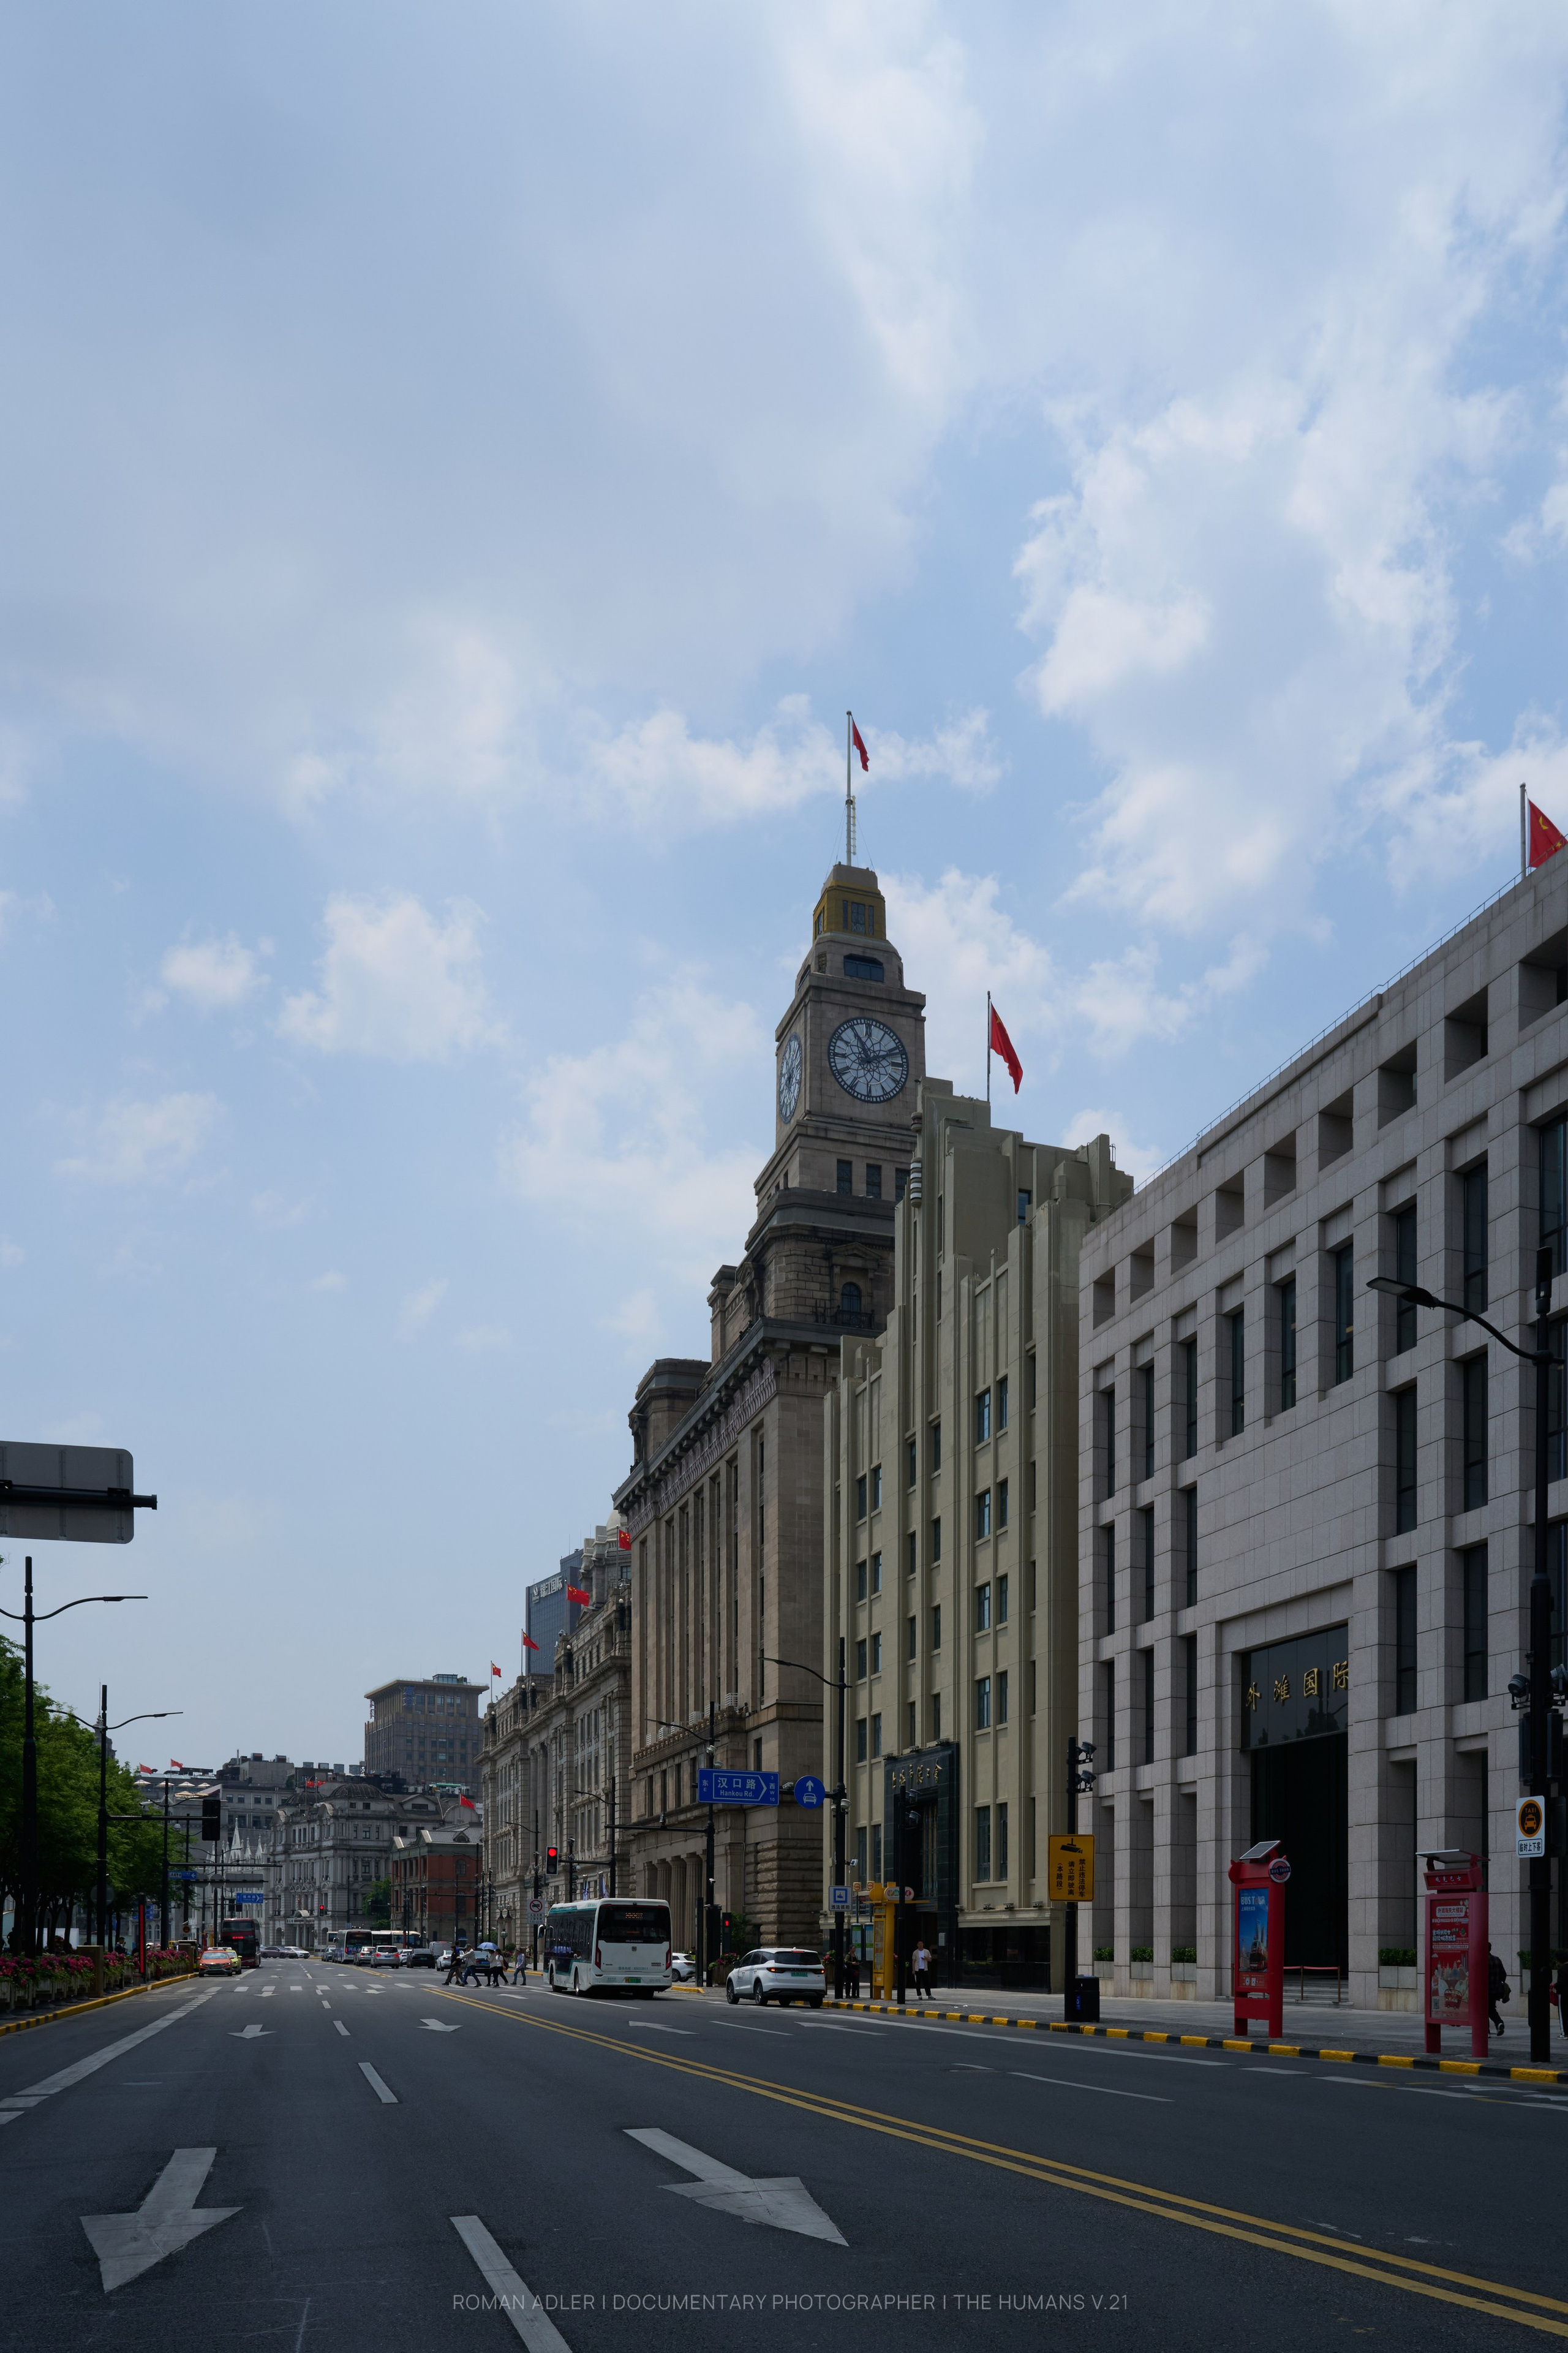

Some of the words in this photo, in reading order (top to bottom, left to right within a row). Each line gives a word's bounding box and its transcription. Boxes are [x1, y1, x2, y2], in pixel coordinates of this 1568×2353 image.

[1246, 1661, 1348, 1712] 外滩国际
[717, 1777, 756, 1790] 汉口路
[1519, 1841, 1541, 1852] 临时上下客
